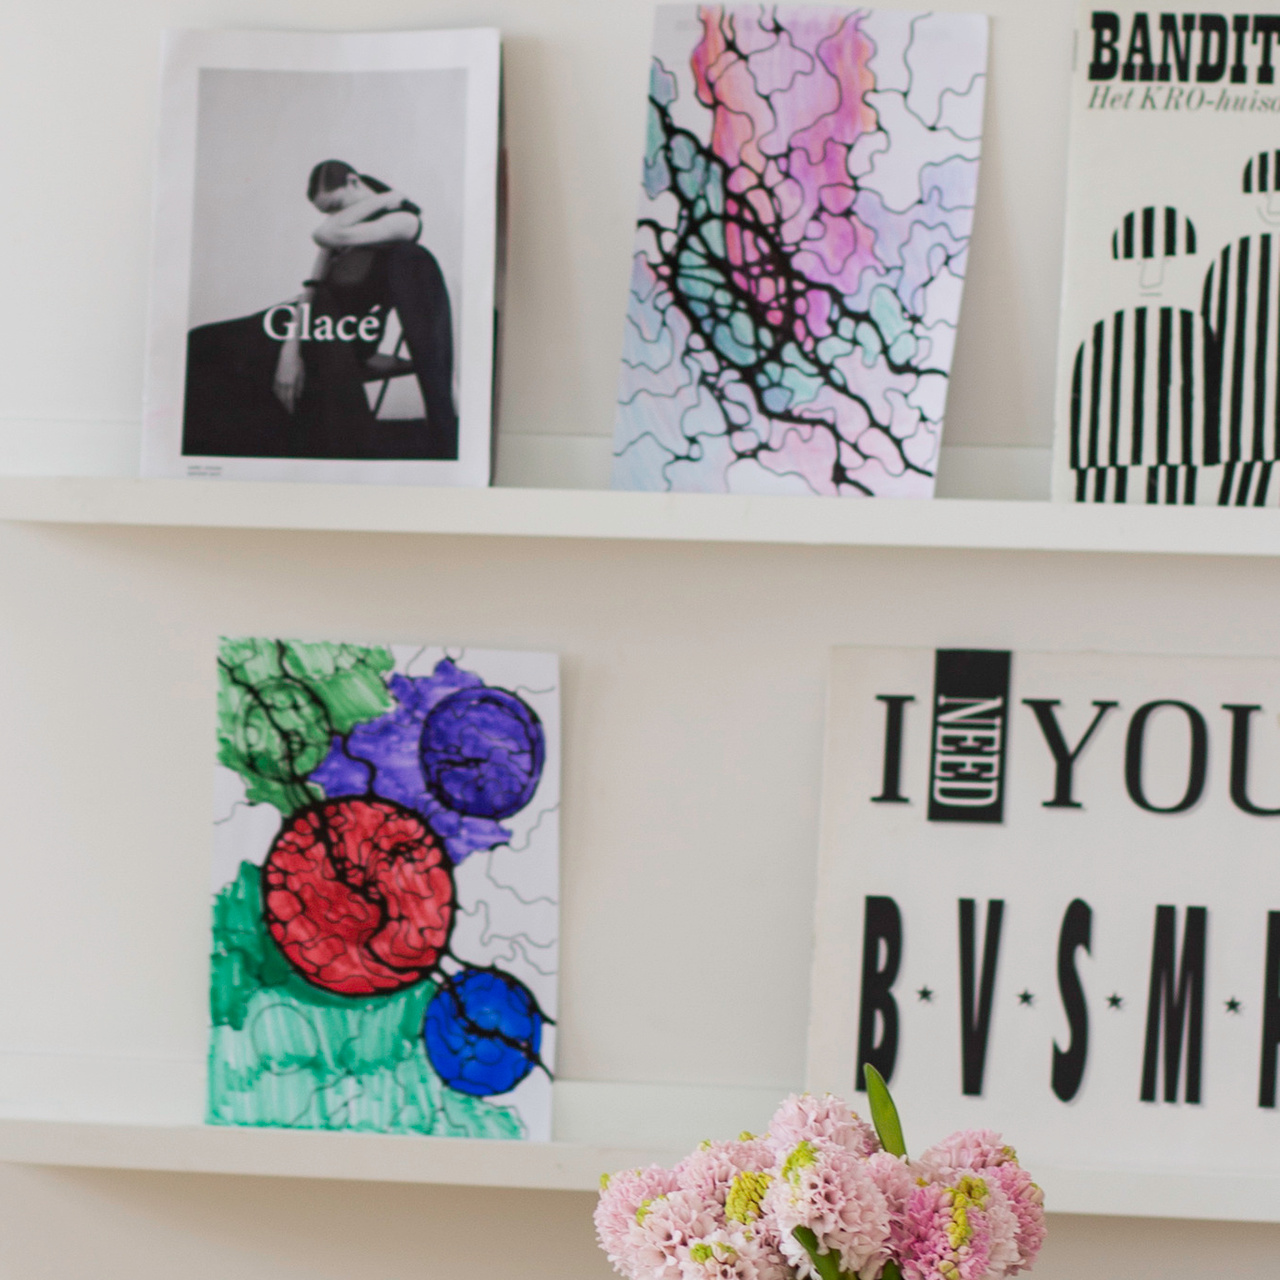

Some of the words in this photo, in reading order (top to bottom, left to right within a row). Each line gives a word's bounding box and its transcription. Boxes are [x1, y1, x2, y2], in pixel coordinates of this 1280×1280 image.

[1088, 11, 1280, 85] BANDIT
[1087, 85, 1133, 110] Het
[263, 302, 381, 341] Glacé
[870, 694, 917, 805] I
[934, 695, 1003, 807] NEED
